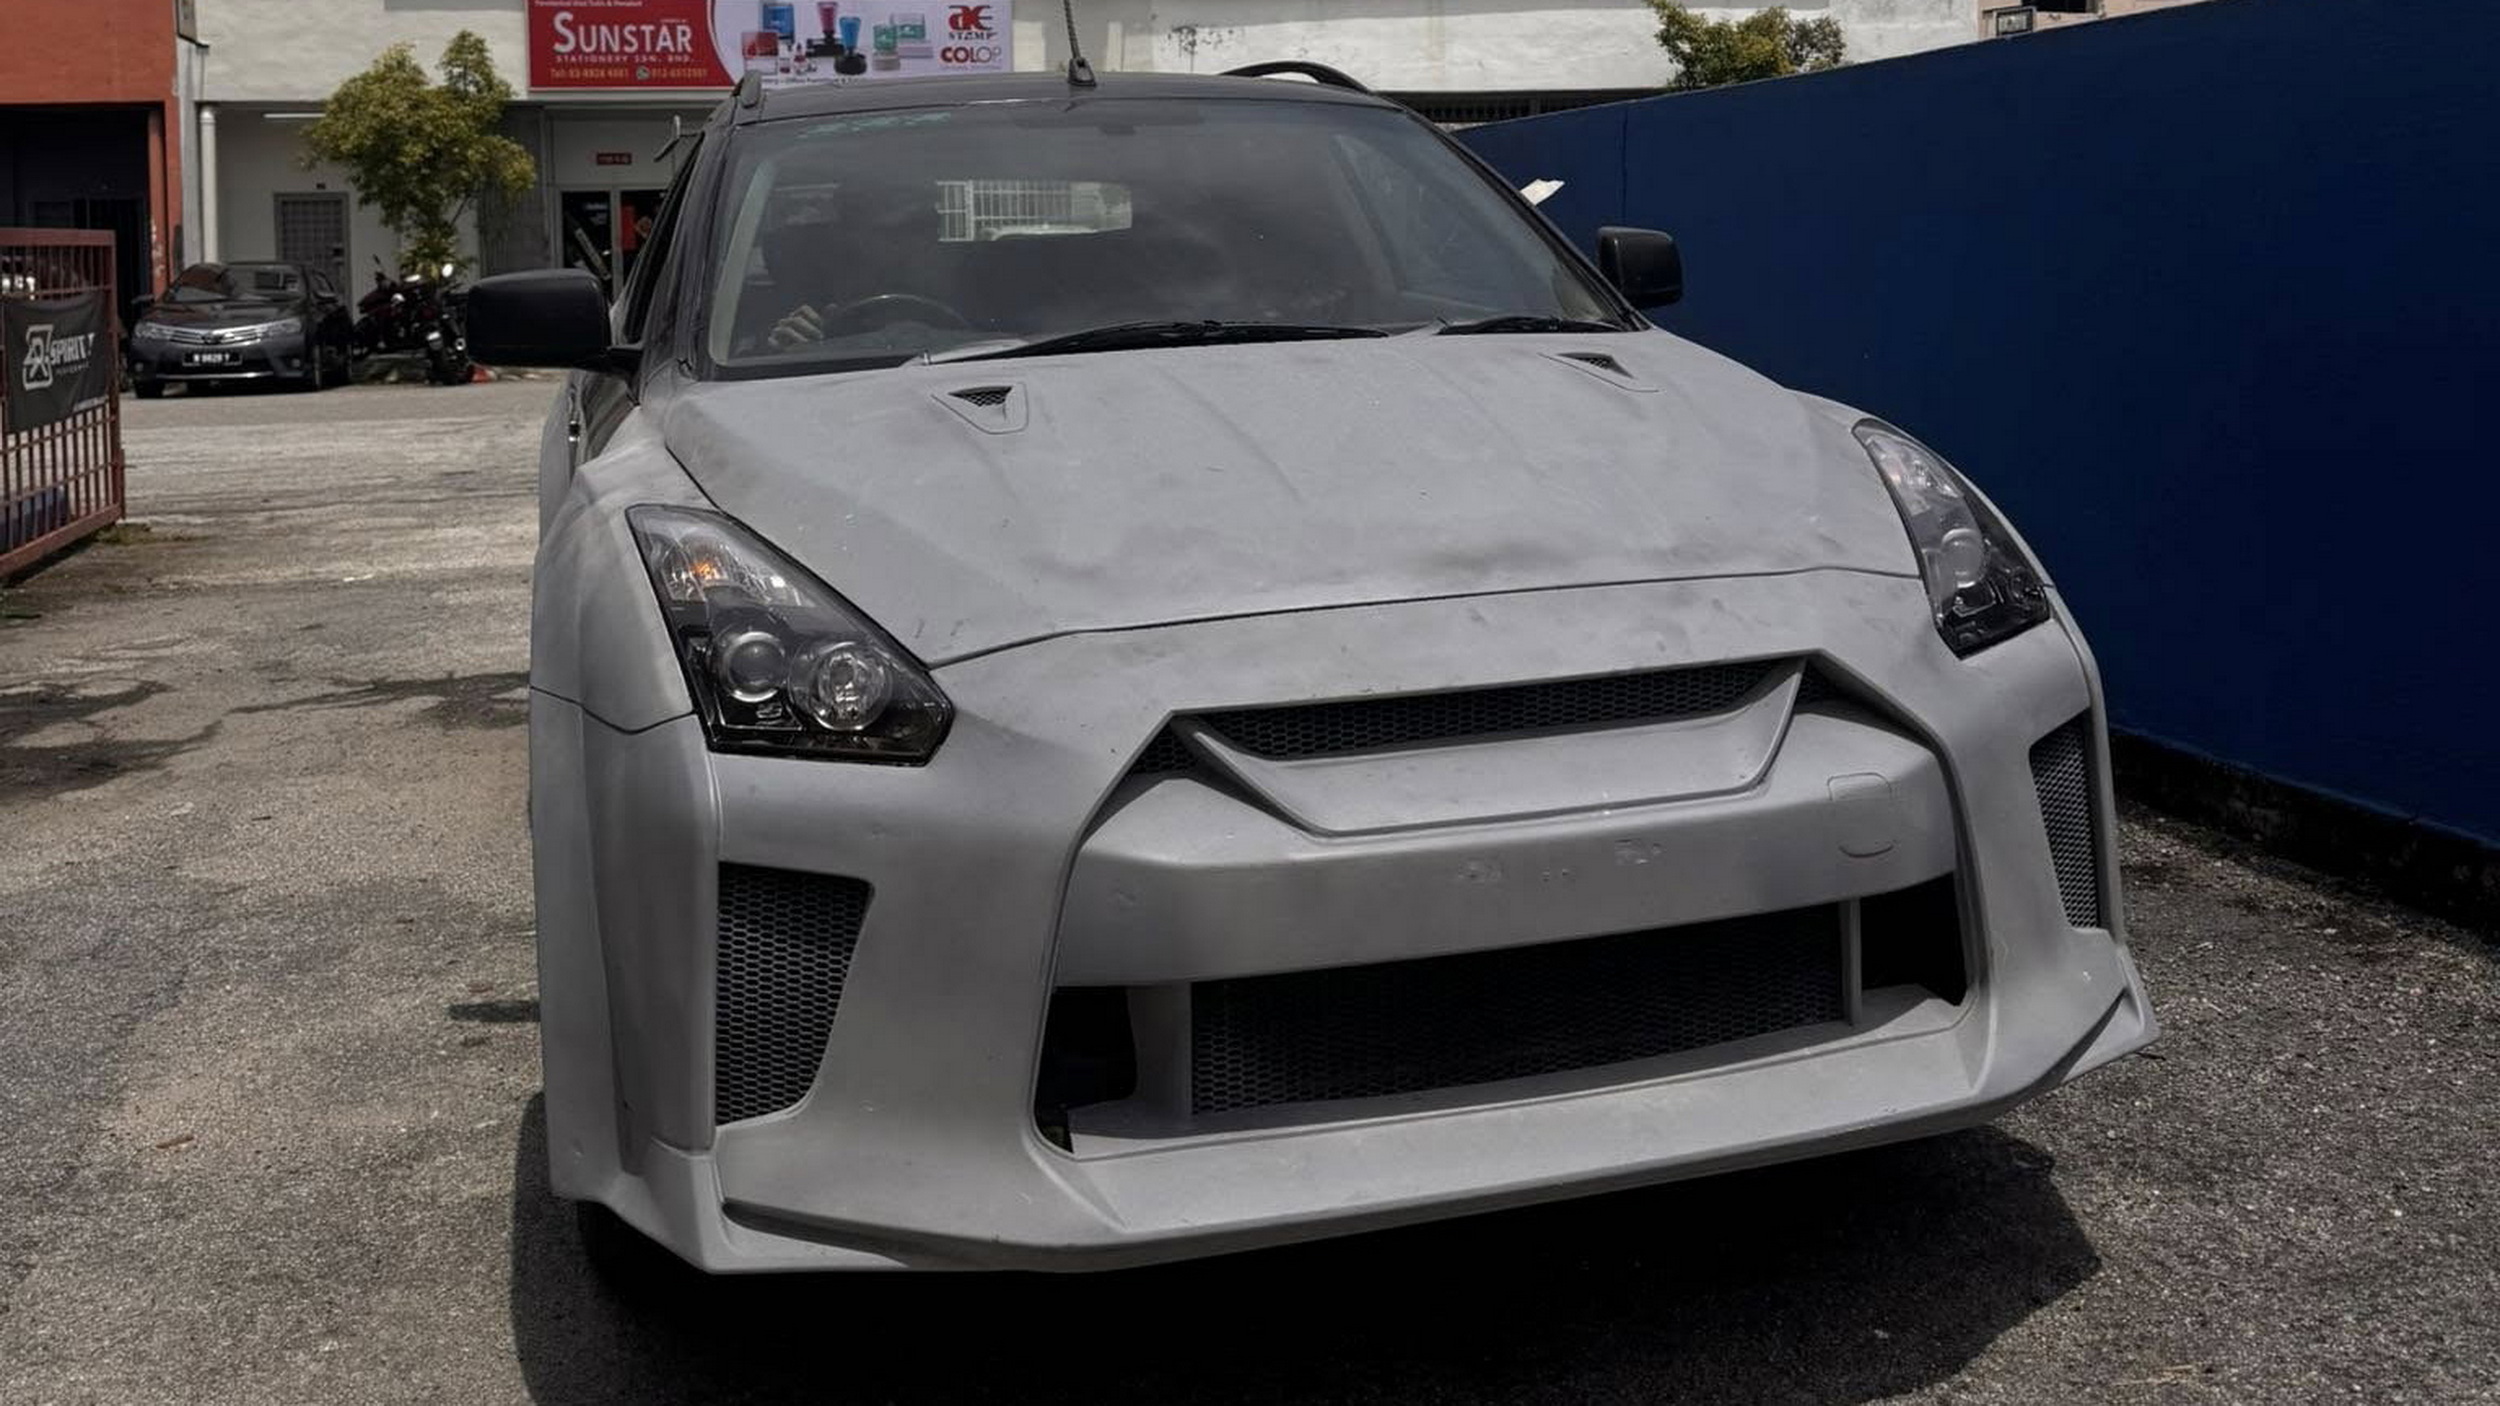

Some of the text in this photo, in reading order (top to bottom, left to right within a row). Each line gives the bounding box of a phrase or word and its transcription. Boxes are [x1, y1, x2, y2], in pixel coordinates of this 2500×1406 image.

[553, 11, 693, 53] SUNSTAR
[556, 54, 628, 63] STATIONERY
[940, 46, 1002, 64] COLOP
